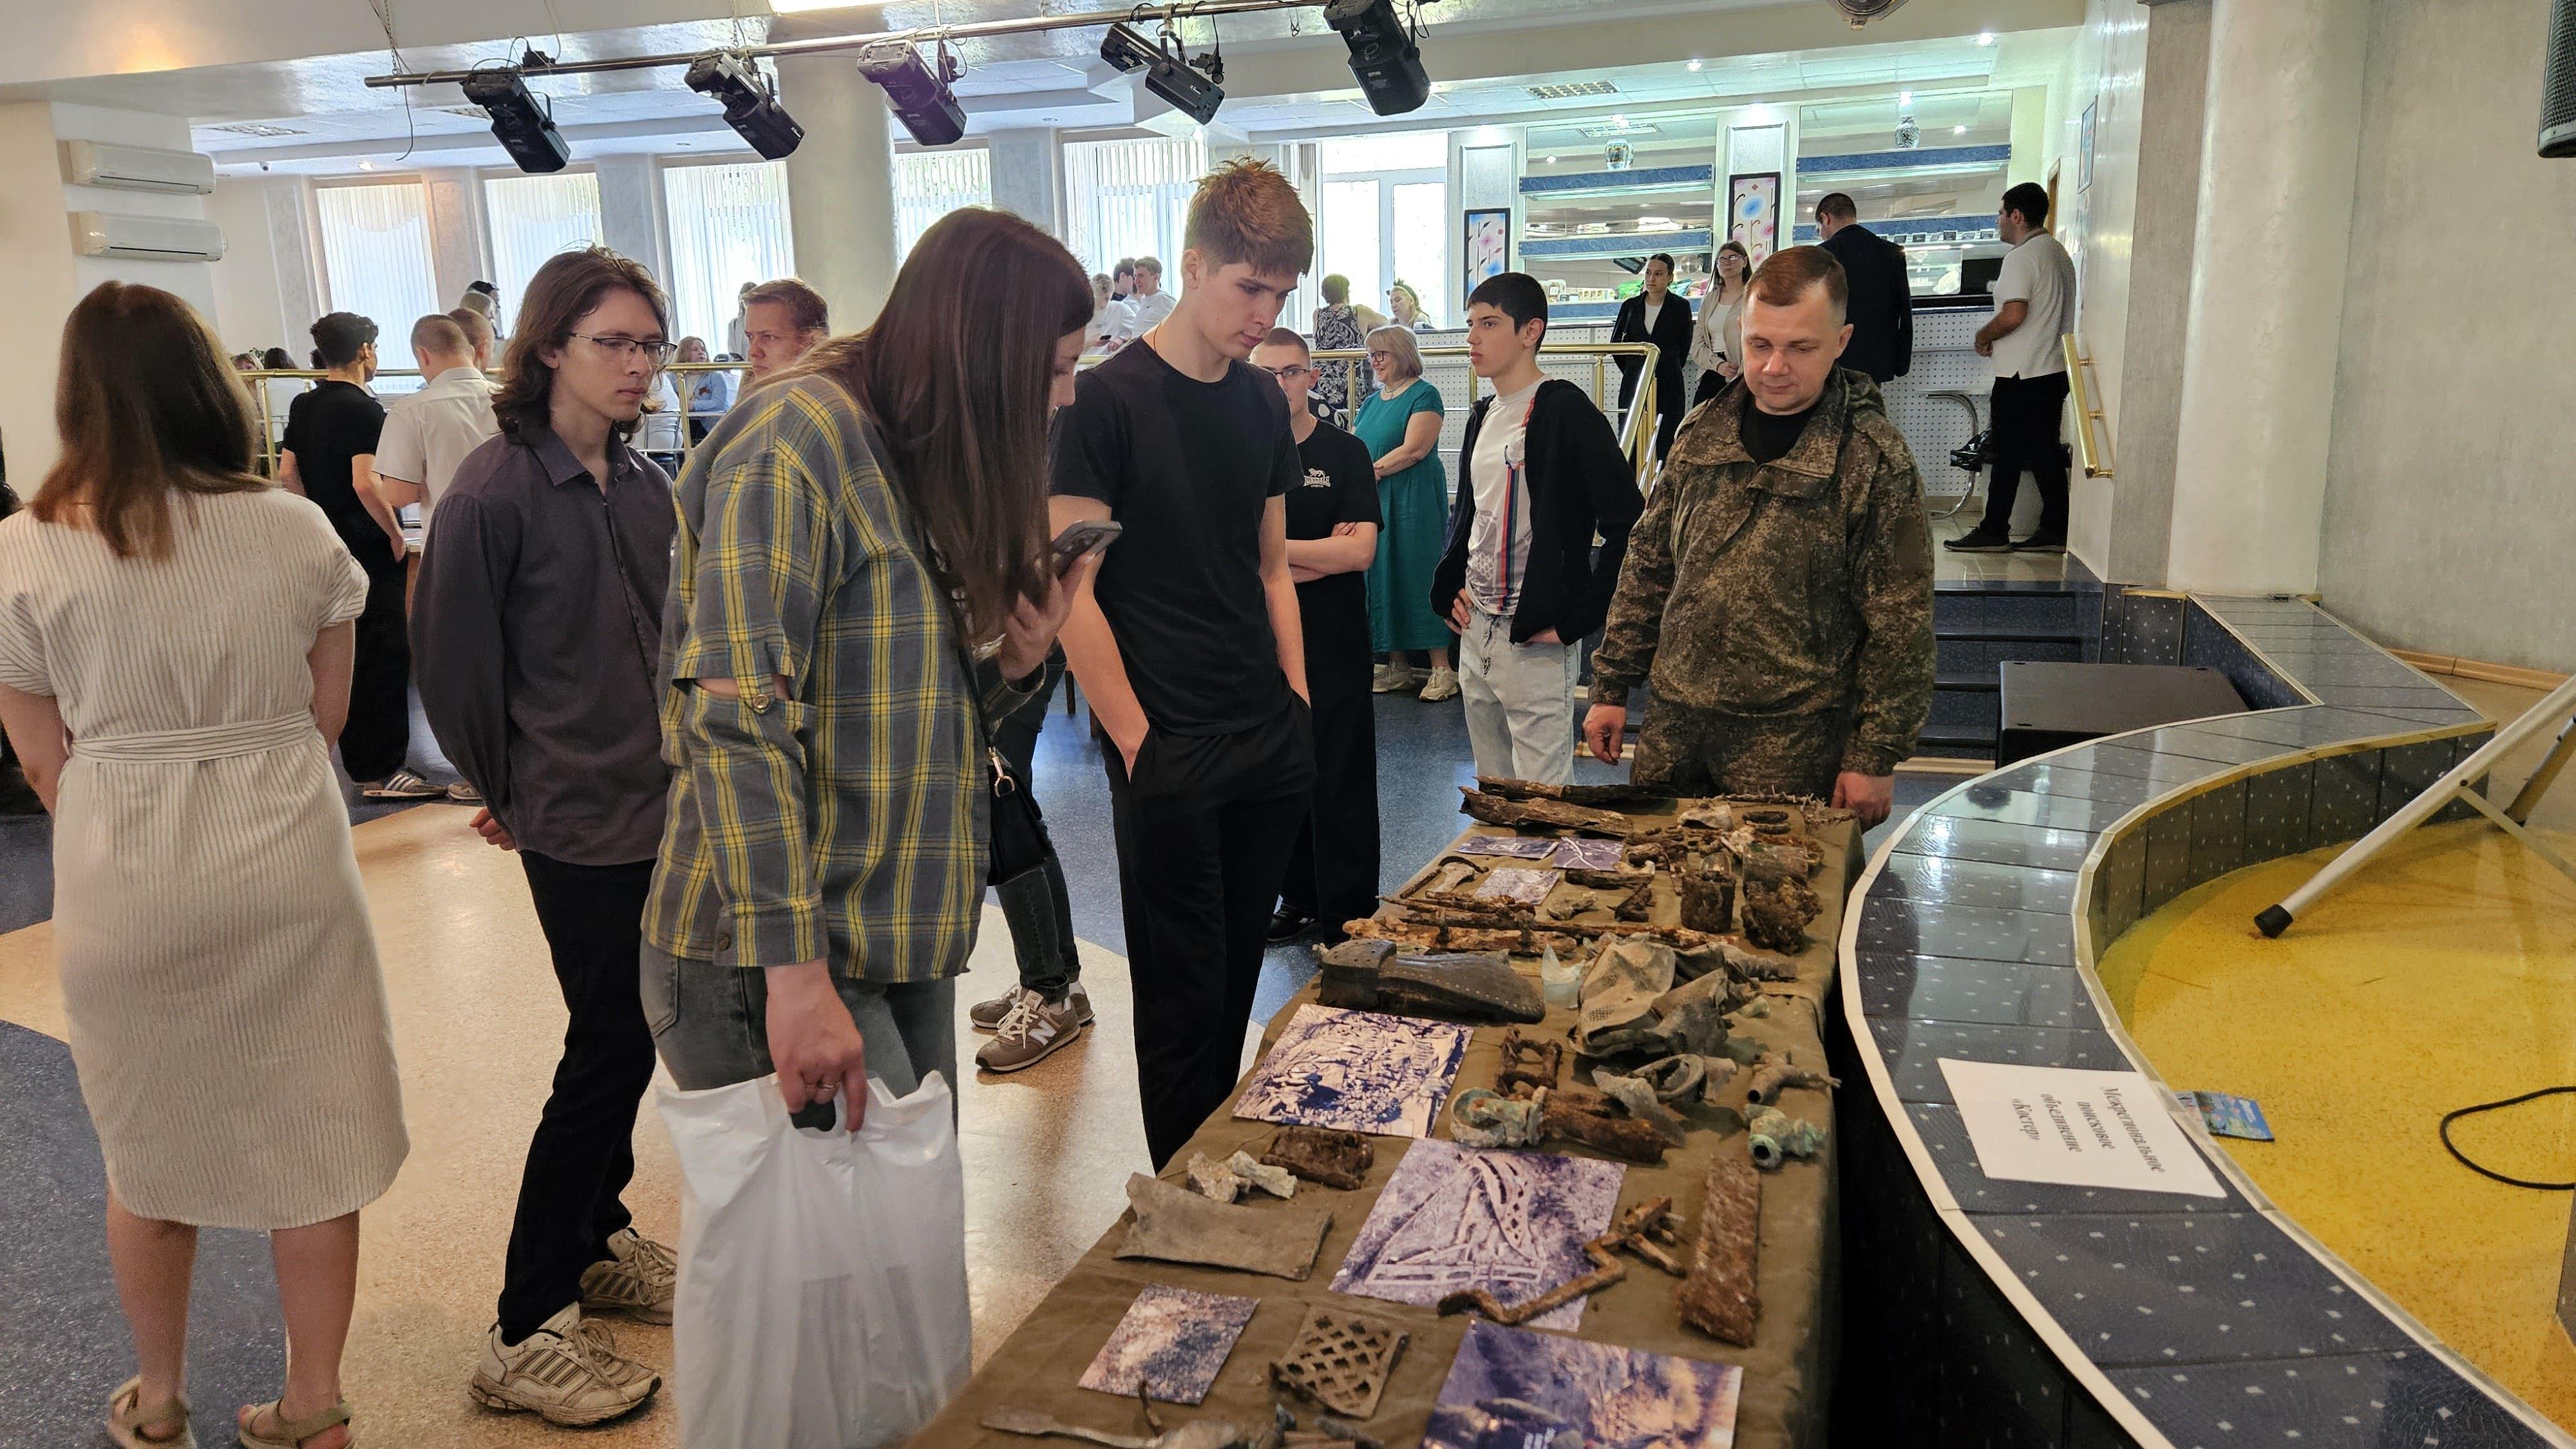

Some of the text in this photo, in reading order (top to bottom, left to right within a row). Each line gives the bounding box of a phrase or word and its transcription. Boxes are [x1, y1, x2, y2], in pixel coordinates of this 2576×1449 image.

[2011, 1098, 2041, 1141] «Костер»
[2040, 1093, 2083, 1153] объединение
[2076, 1101, 2116, 1150] поисковое
[2100, 1086, 2165, 1172] Межрегиональное
